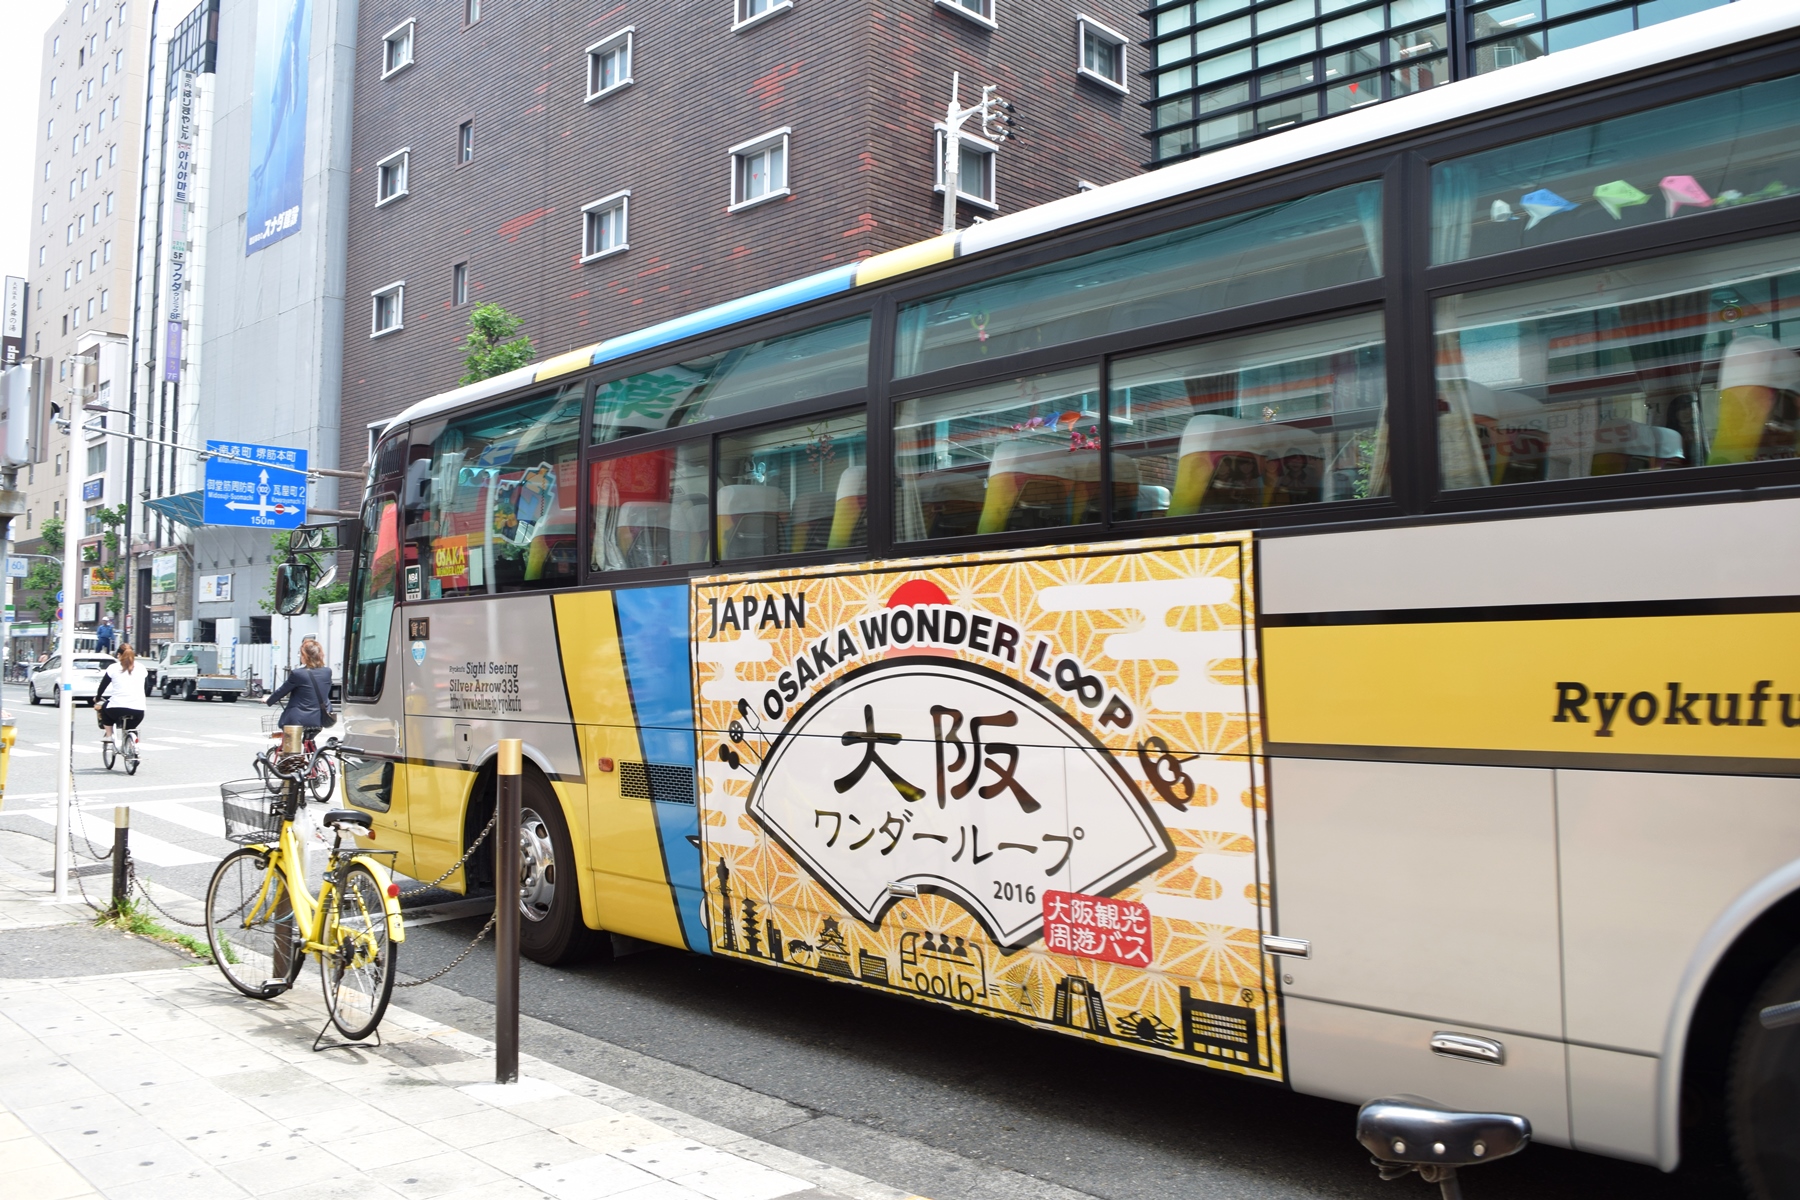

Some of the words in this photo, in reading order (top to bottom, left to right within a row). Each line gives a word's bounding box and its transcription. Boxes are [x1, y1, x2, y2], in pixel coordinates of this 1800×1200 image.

[176, 151, 189, 202] 아시아마트
[251, 516, 275, 525] 150m
[435, 546, 466, 567] OSAKA
[708, 592, 806, 638] JAPAN
[466, 662, 486, 678] Sight
[489, 662, 519, 678] Seeing
[763, 628, 859, 720] OSAKA
[859, 609, 1020, 664] WONDER
[449, 679, 474, 692] Silver
[474, 679, 519, 694] Arrow335
[1552, 680, 1800, 737] Ryokufu
[833, 704, 1042, 814] 大阪
[815, 808, 1086, 877] ワンダーループ
[992, 880, 1036, 905] 2016
[1047, 896, 1148, 935] 大阪観光
[1048, 923, 1150, 963] 周遊バス
